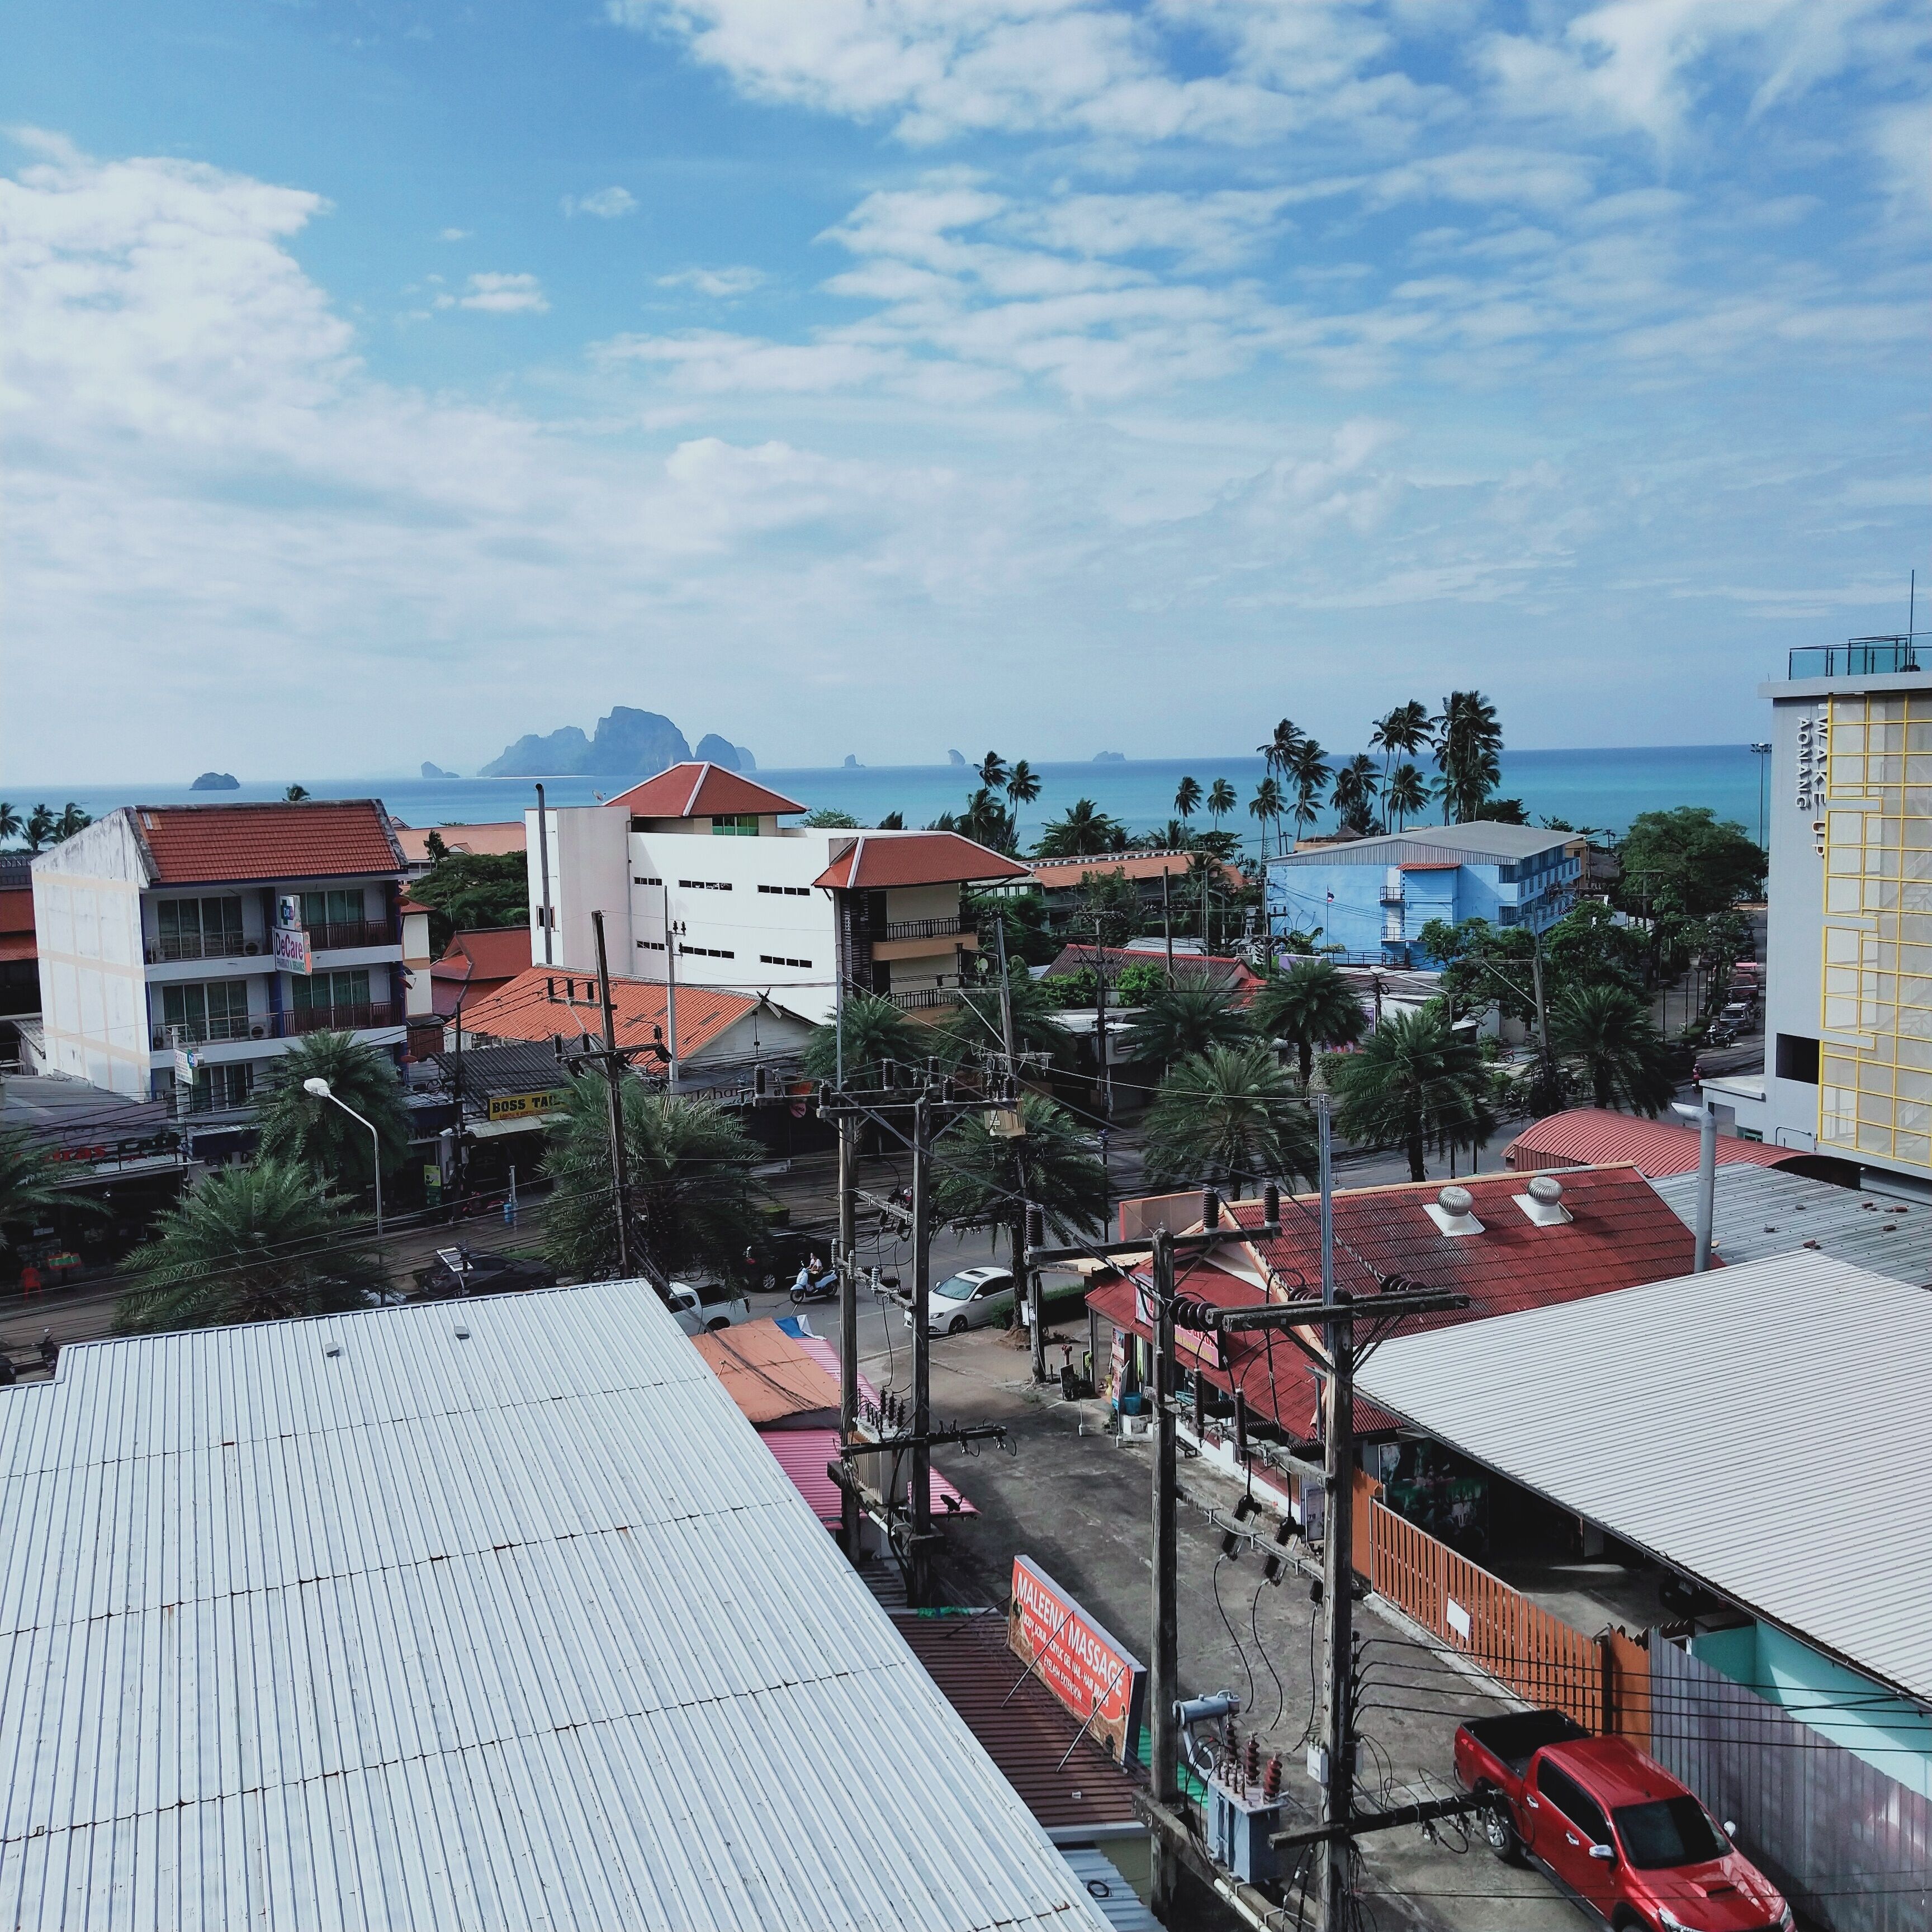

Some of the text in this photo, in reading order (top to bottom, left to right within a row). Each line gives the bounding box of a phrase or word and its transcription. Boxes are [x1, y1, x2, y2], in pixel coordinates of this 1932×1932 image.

[1796, 717, 1810, 807] AONANG
[1812, 716, 1828, 856] WAKE UP
[275, 932, 303, 960] DeCare
[492, 1098, 526, 1114] BOSS
[1017, 1571, 1124, 1698] MALEENA MASSAGE
